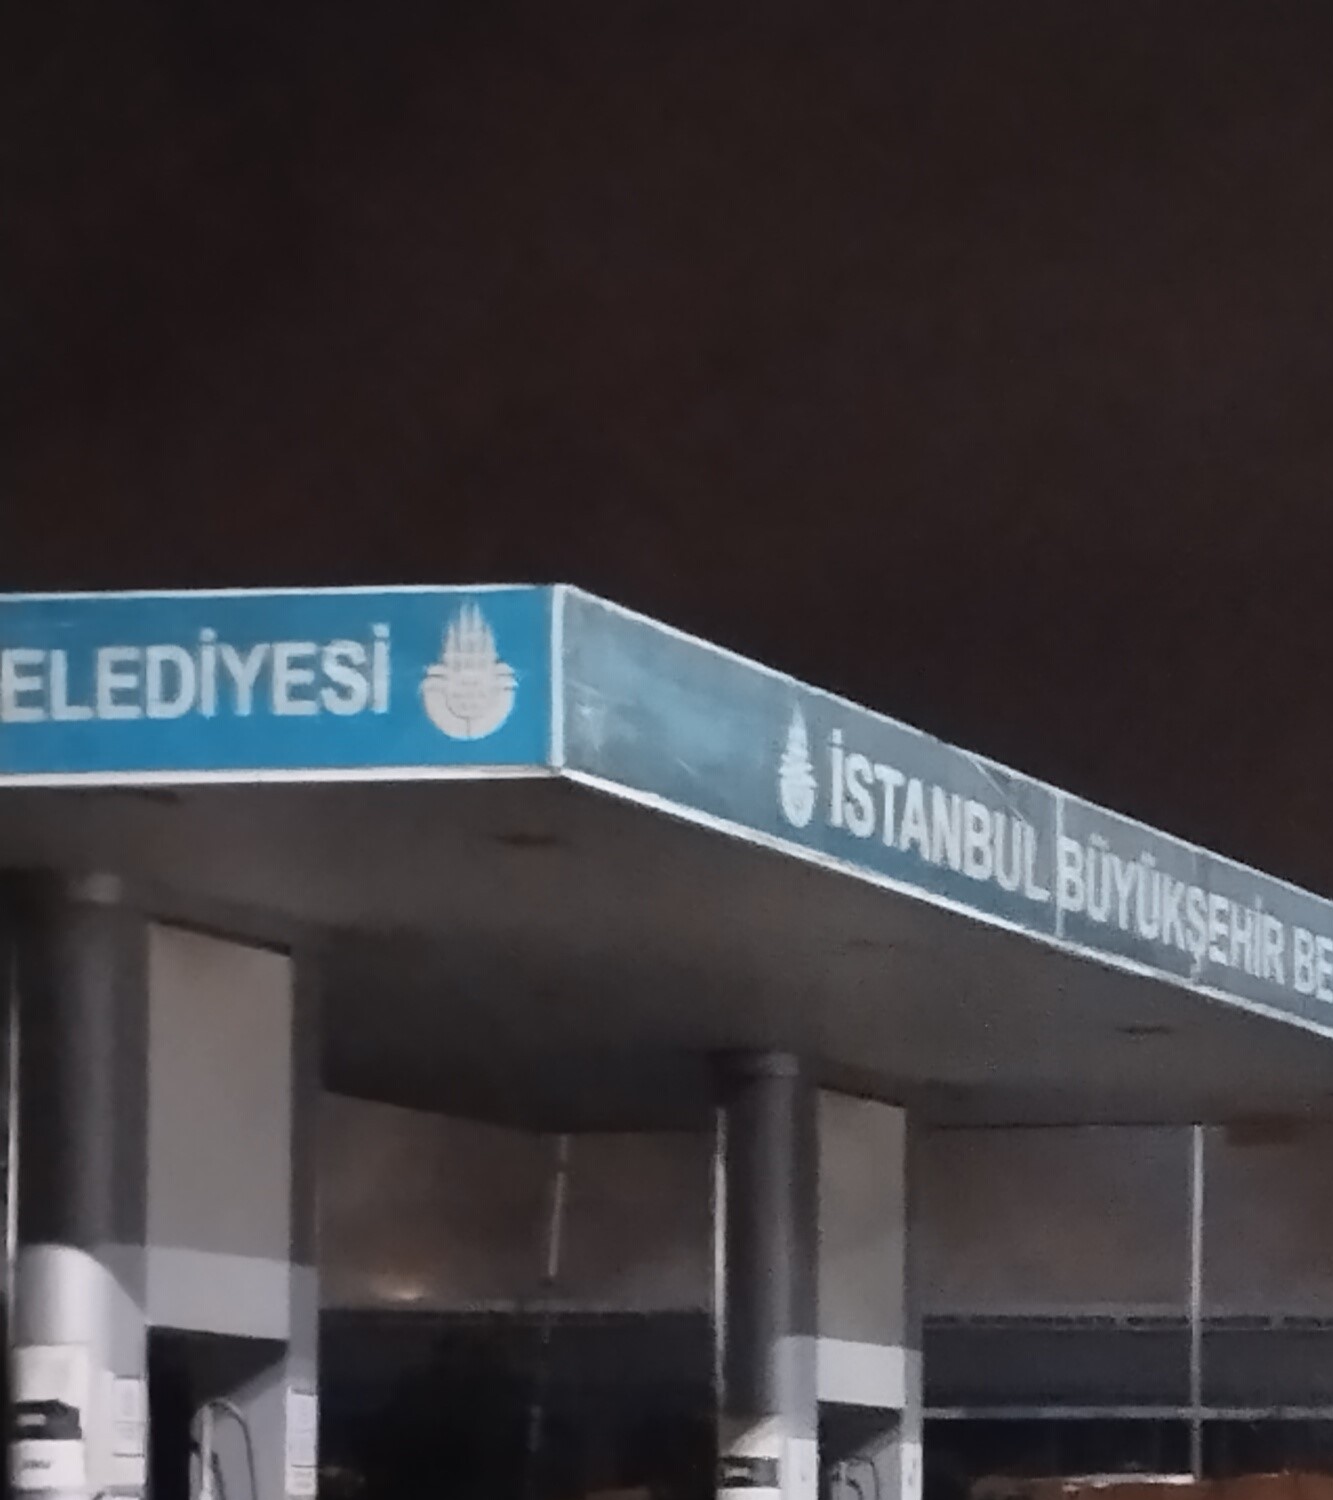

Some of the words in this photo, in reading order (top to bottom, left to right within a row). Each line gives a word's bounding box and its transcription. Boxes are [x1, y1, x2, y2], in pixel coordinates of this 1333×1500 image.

[0, 623, 391, 723] ELEDİYESİ
[829, 728, 1051, 901] İSTANBUL
[1056, 832, 1286, 986] BÜYÜKŞEHİR
